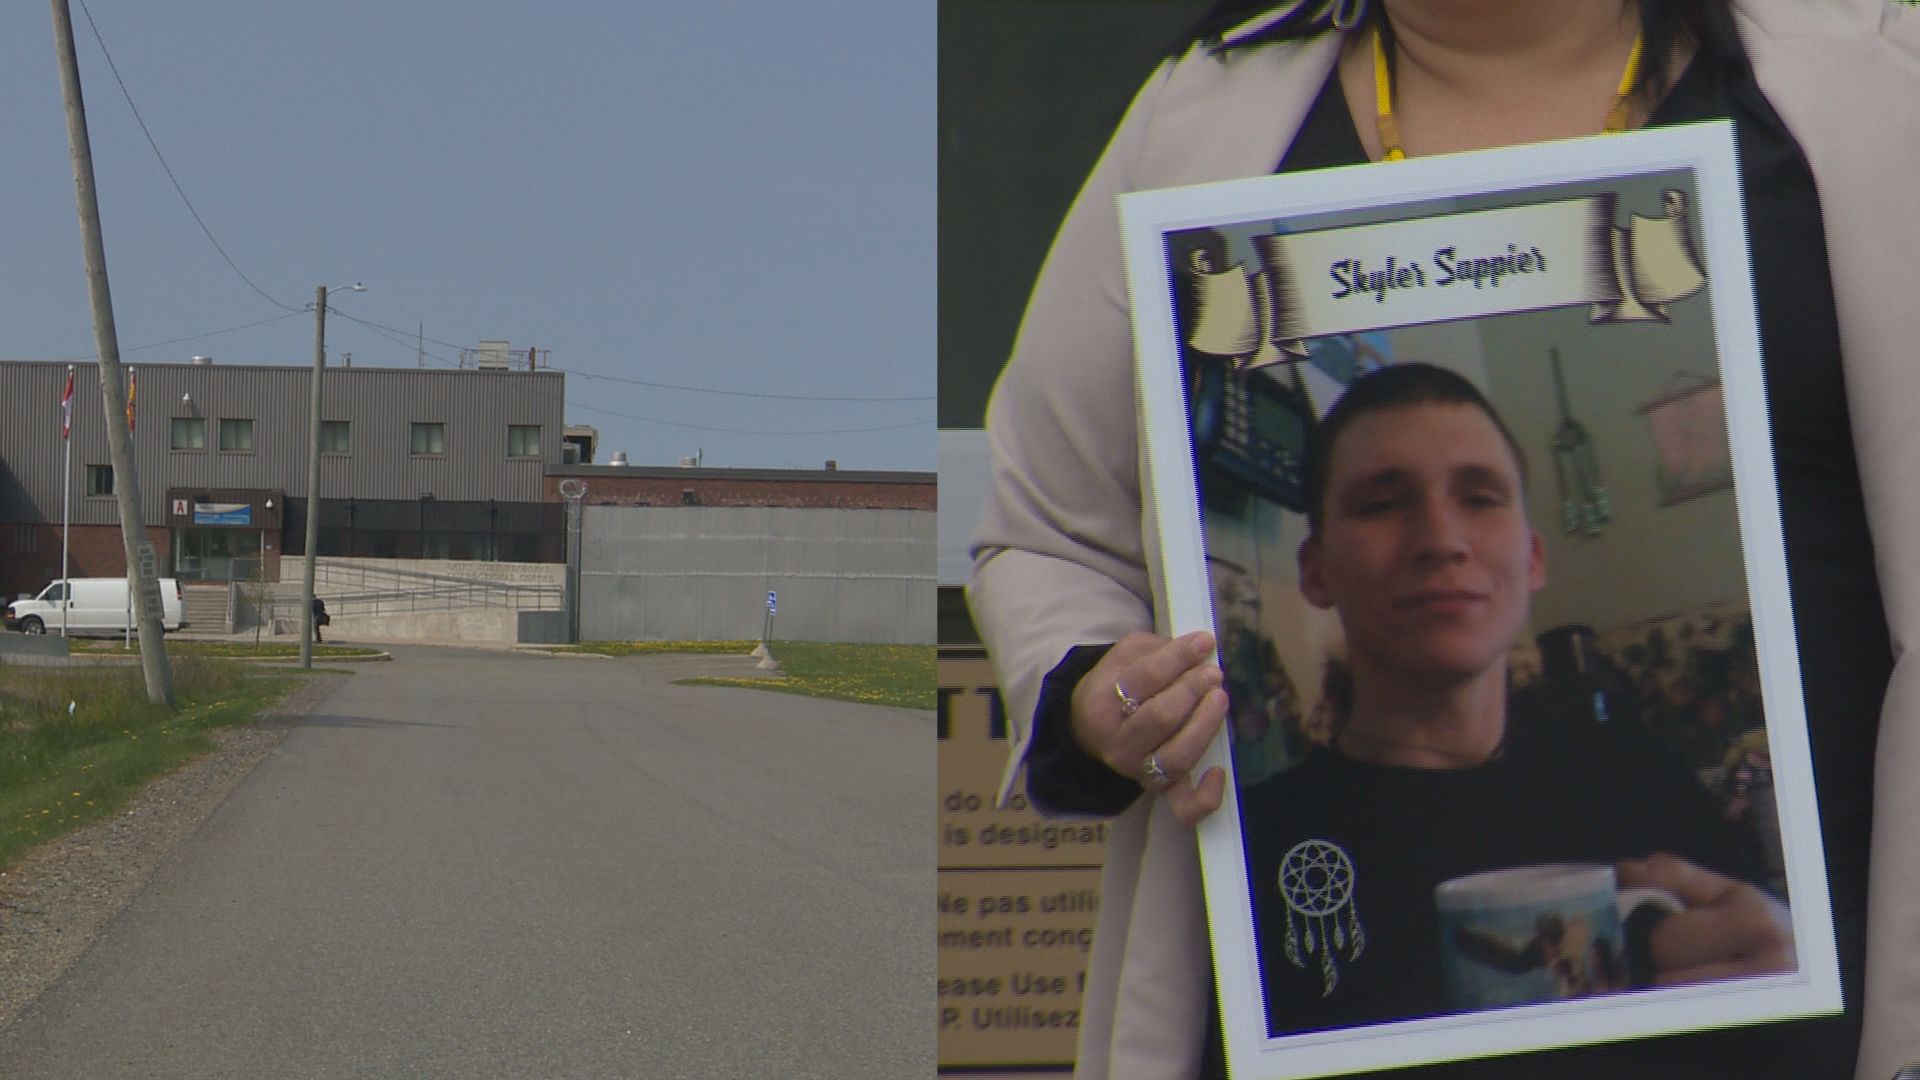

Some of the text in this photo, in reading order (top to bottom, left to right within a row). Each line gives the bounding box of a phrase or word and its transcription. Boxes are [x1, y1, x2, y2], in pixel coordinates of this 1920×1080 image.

[1329, 243, 1547, 303] Skyler Sappier
[176, 500, 185, 513] A
[943, 788, 982, 813] do
[943, 822, 969, 846] is
[977, 896, 1032, 920] pas
[1010, 970, 1067, 996] Use
[972, 1006, 1081, 1032] Utilisez
